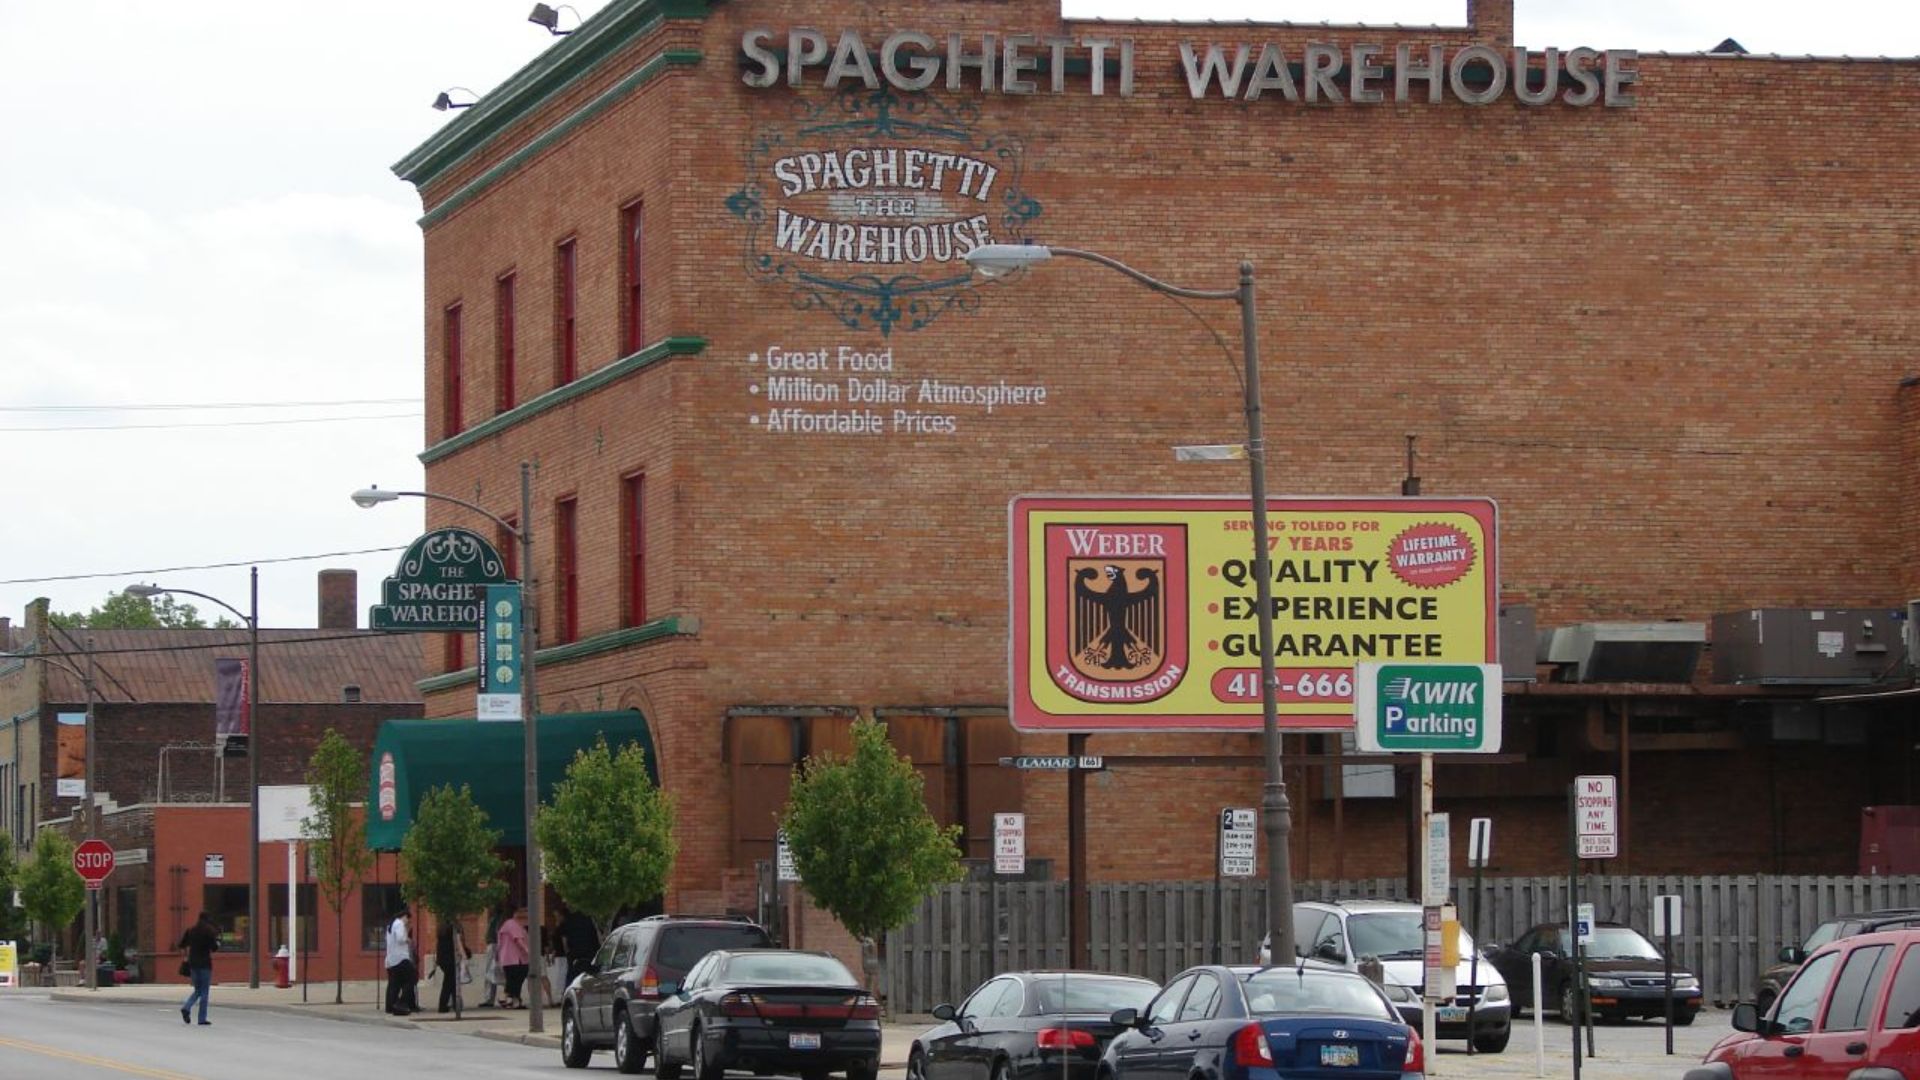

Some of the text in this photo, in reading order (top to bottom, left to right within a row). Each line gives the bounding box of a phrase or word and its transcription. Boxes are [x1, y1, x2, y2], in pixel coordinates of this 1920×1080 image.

[741, 27, 1639, 106] SPAGHETTI WAREHOUSE
[774, 148, 998, 201] SPAGHETTI
[855, 197, 916, 217] THE
[776, 208, 996, 264] WAREHOUSE
[767, 345, 893, 371] Great Food
[767, 377, 1047, 414] Million Dollar Atmosphere
[767, 408, 956, 434] Affordable Prices
[1291, 521, 1346, 531] TOLEDO
[1352, 521, 1380, 532] FOR
[1288, 536, 1354, 551] YEARS
[1403, 534, 1458, 552] LIFETIME
[1396, 548, 1467, 568] WARRANTY
[439, 566, 465, 578] THE
[399, 583, 476, 600] SPAGHE
[390, 605, 478, 622] WAREHO
[1223, 596, 1438, 620] EXPERIENCE
[1057, 664, 1182, 698] TRANSMISSION
[1227, 673, 1352, 697] 41-666
[1384, 677, 1478, 705] KWIK
[1386, 706, 1477, 737] Parking
[1022, 758, 1071, 768] LAMAR
[1588, 782, 1603, 793] NO
[1003, 817, 1015, 826] NO
[1224, 812, 1233, 825] 2
[1588, 811, 1605, 819] ANY
[1585, 822, 1607, 831] TIME
[77, 853, 112, 868] STOP
